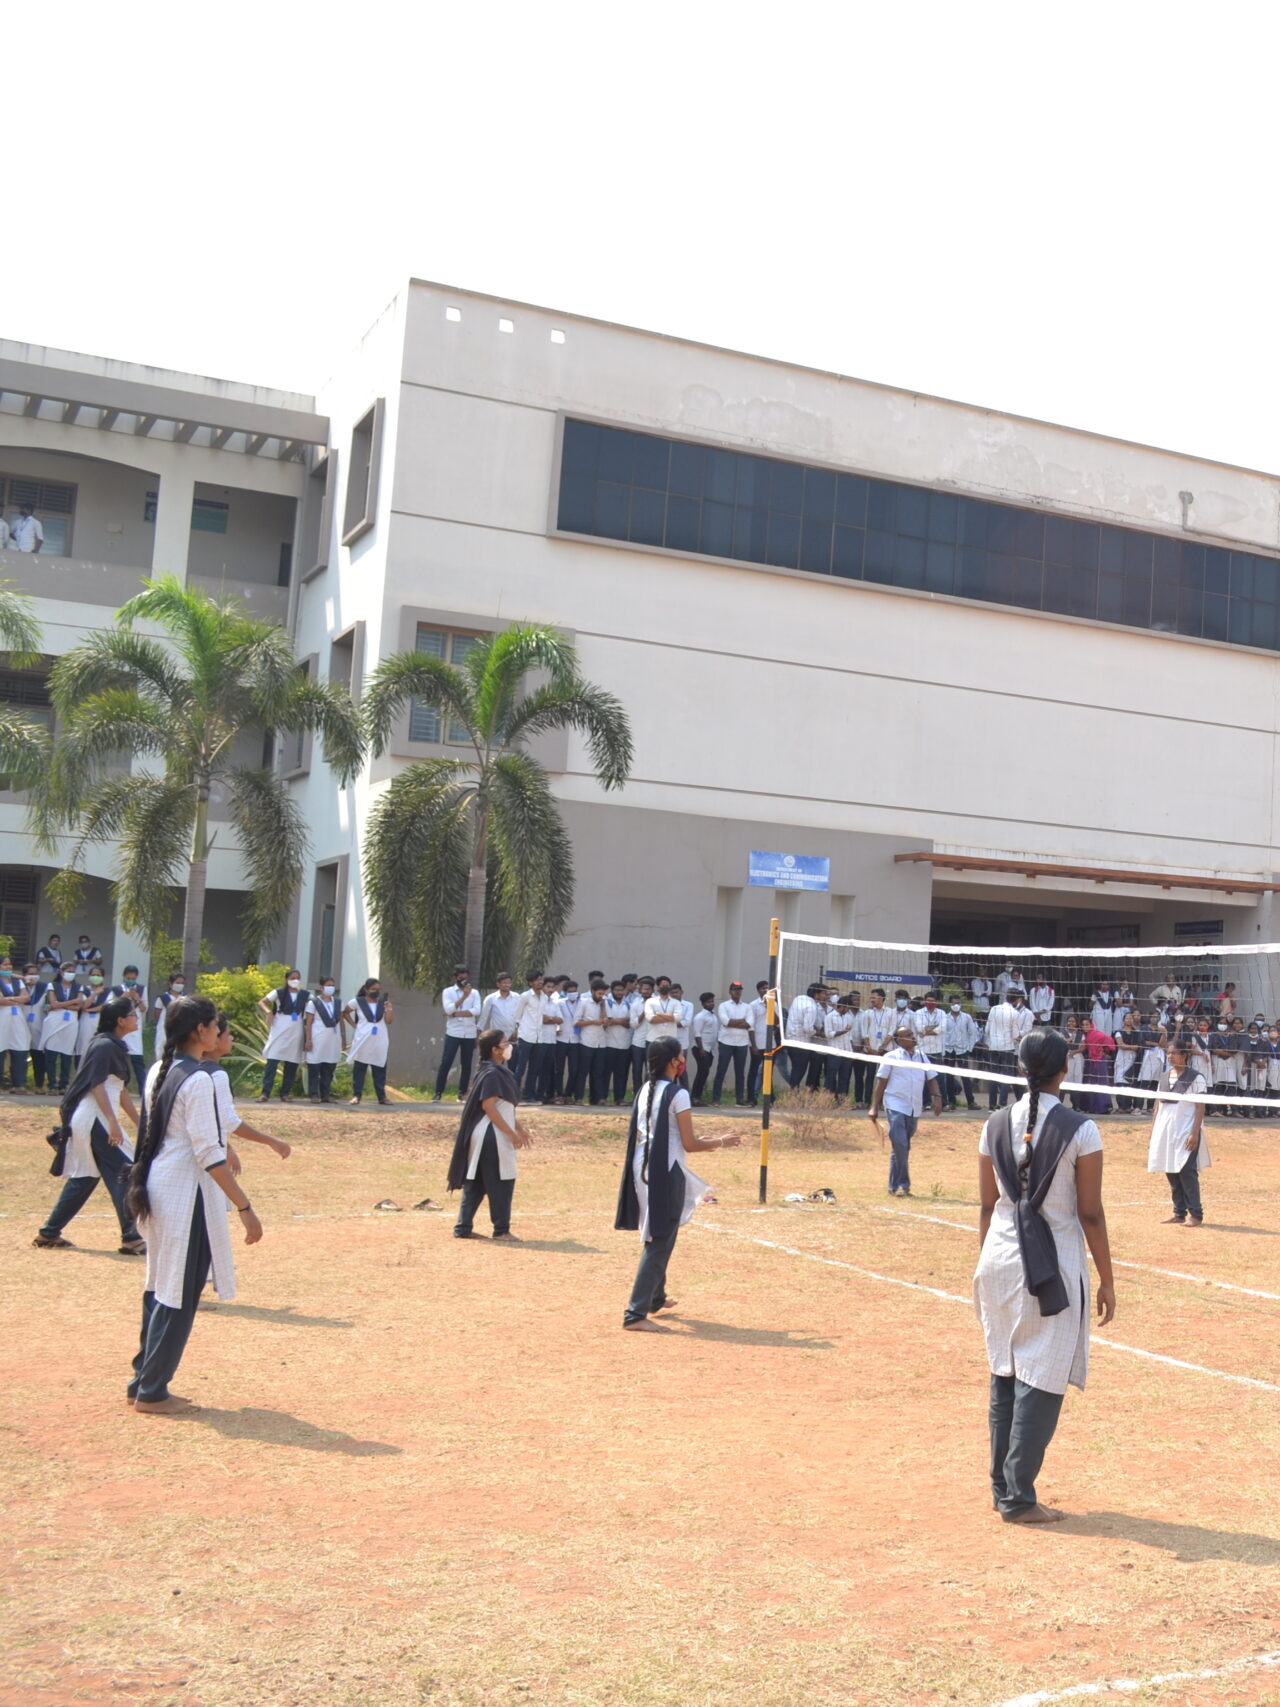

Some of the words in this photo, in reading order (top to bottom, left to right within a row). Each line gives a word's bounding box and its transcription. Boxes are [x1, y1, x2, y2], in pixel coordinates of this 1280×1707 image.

[750, 870, 779, 878] ELECTRONICS
[791, 873, 828, 882] COMMUNICATION
[774, 879, 803, 887] ENGINEERING
[880, 974, 902, 982] BOARD
